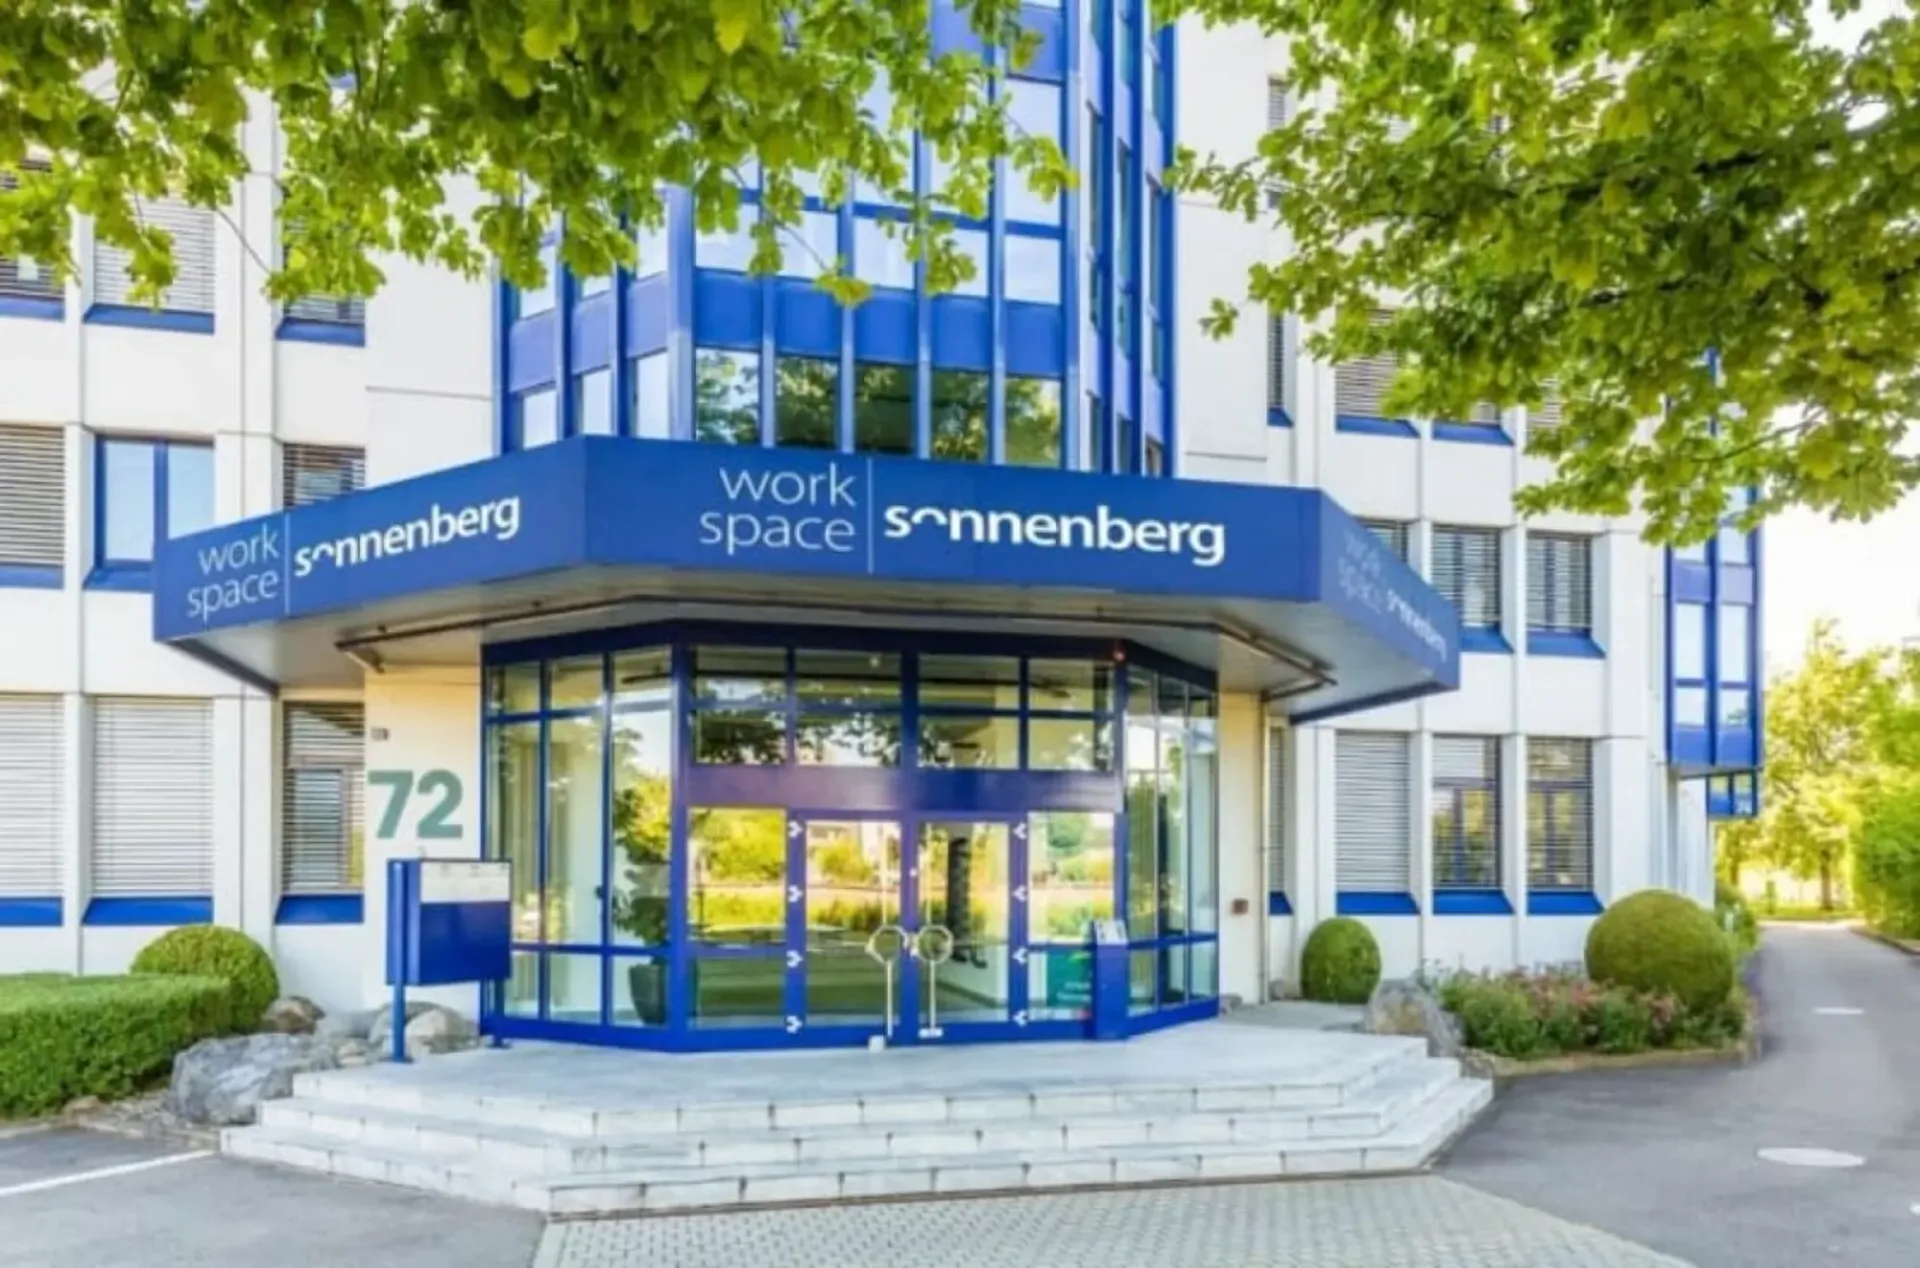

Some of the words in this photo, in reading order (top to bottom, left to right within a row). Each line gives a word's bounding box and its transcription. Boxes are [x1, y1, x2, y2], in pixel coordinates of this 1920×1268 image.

[718, 461, 856, 507] work
[198, 523, 280, 575] work
[699, 510, 856, 556] space
[186, 569, 280, 621] space
[366, 769, 464, 839] 72
